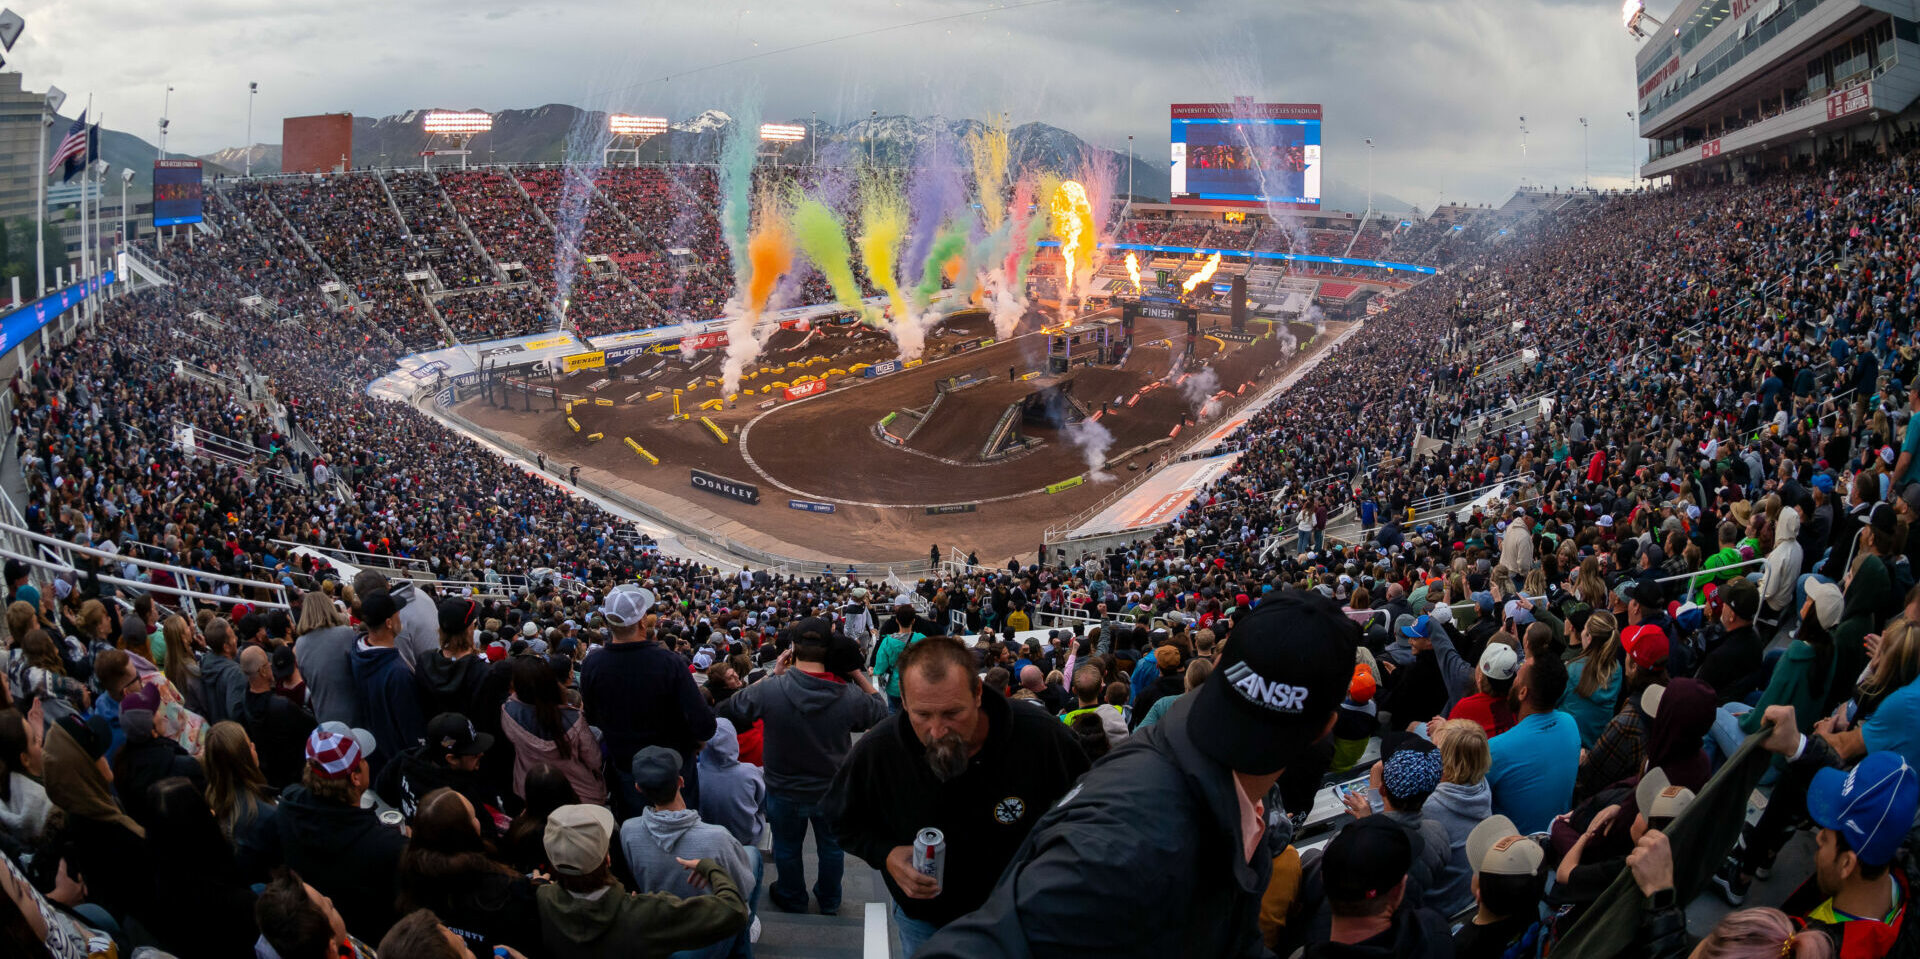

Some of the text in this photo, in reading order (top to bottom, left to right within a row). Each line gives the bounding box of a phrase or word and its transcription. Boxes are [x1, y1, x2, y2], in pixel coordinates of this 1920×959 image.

[1142, 307, 1175, 319] FINISH
[606, 346, 643, 359] FALKEN
[571, 356, 603, 366] DUNLOP
[789, 383, 815, 396] FLY
[707, 480, 753, 499] OAKLEY
[1236, 672, 1309, 710] ANSR
